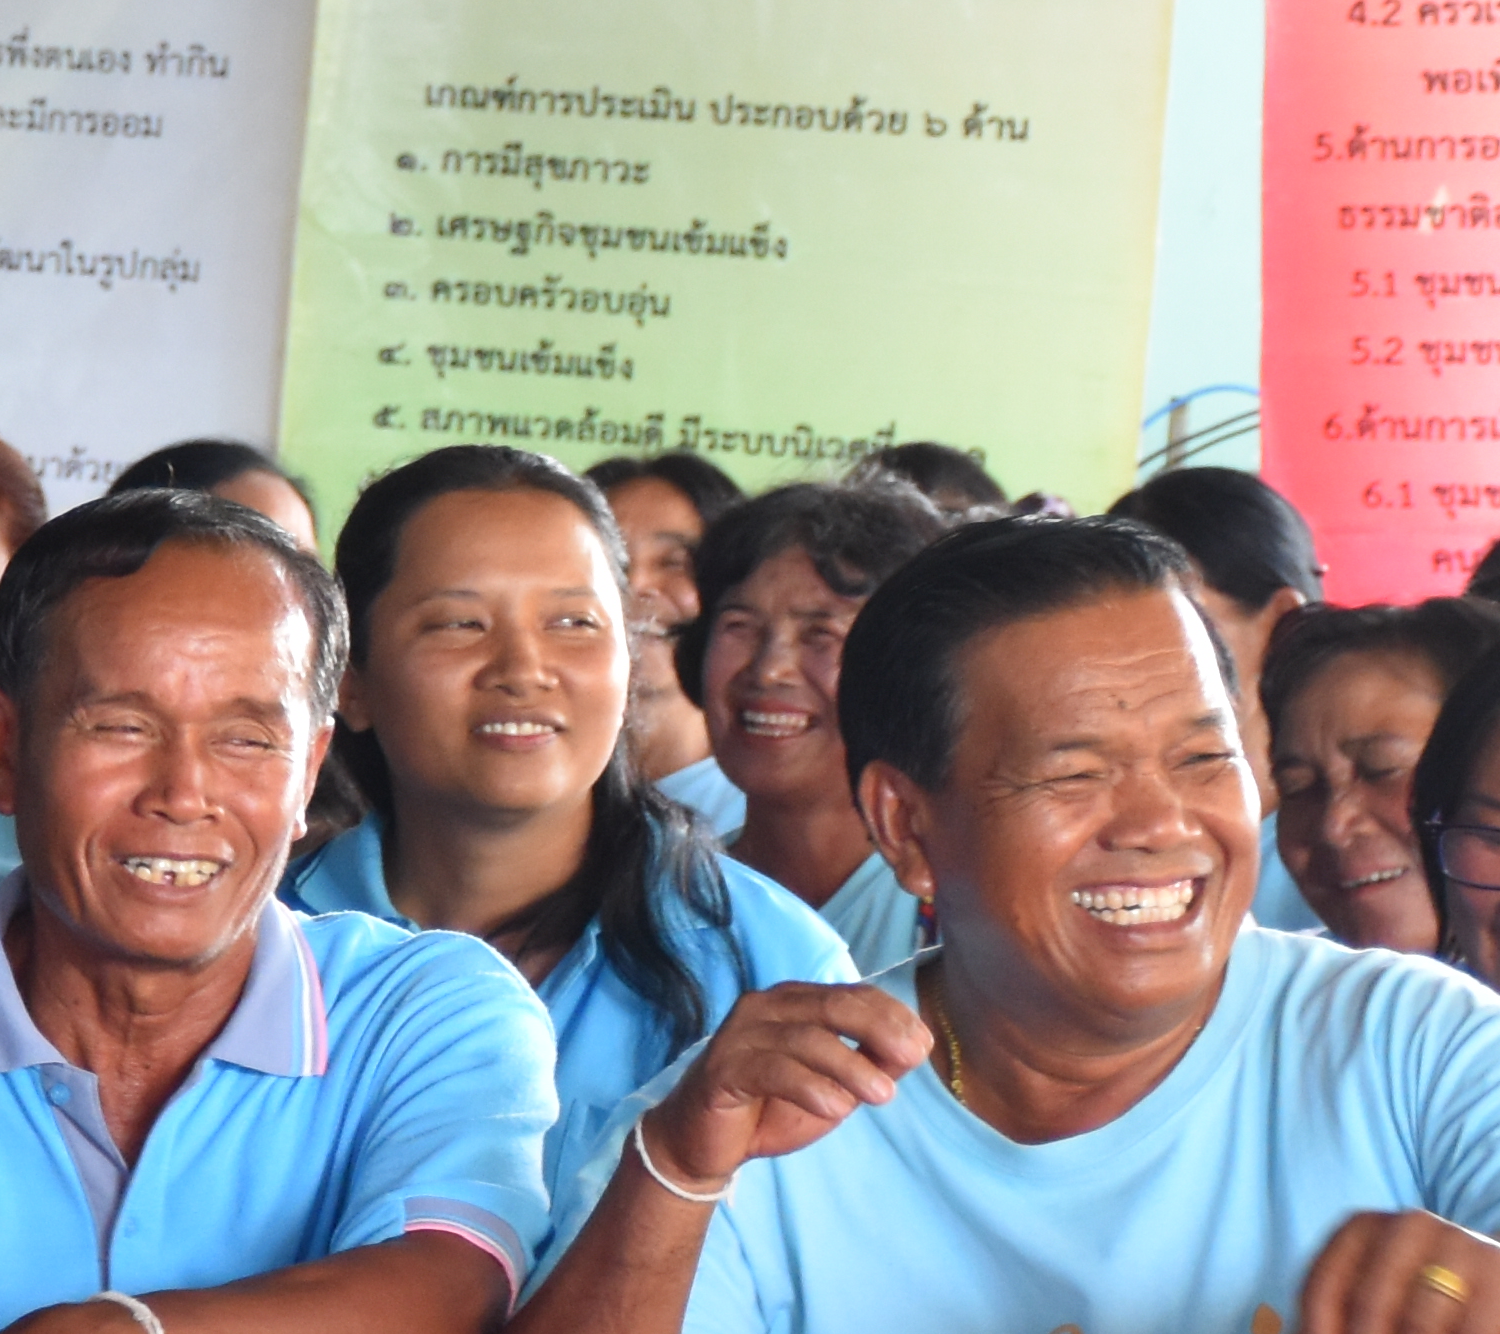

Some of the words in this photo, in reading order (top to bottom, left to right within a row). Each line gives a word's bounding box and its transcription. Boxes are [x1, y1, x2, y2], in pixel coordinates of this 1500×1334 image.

[144, 41, 231, 81] ทำกิน
[424, 75, 697, 126] เกณฑ์การประเมิน
[709, 94, 909, 139] ประกอบด้วย
[963, 109, 1031, 144] ด้าน
[440, 141, 652, 188] การมีสุขภาวะ
[435, 207, 790, 265] เศรษฐกิจชุมชนเข้มแข็ง
[430, 274, 673, 328] ครอบครัวอบอุ่น
[1350, 270, 1400, 302] 5.1
[425, 339, 635, 386] ชุมชนเข้มแข็ง
[1350, 335, 1405, 367] 5.2
[419, 404, 666, 452] สภาพแวดล้อมดี
[1361, 479, 1413, 511] 6.1
